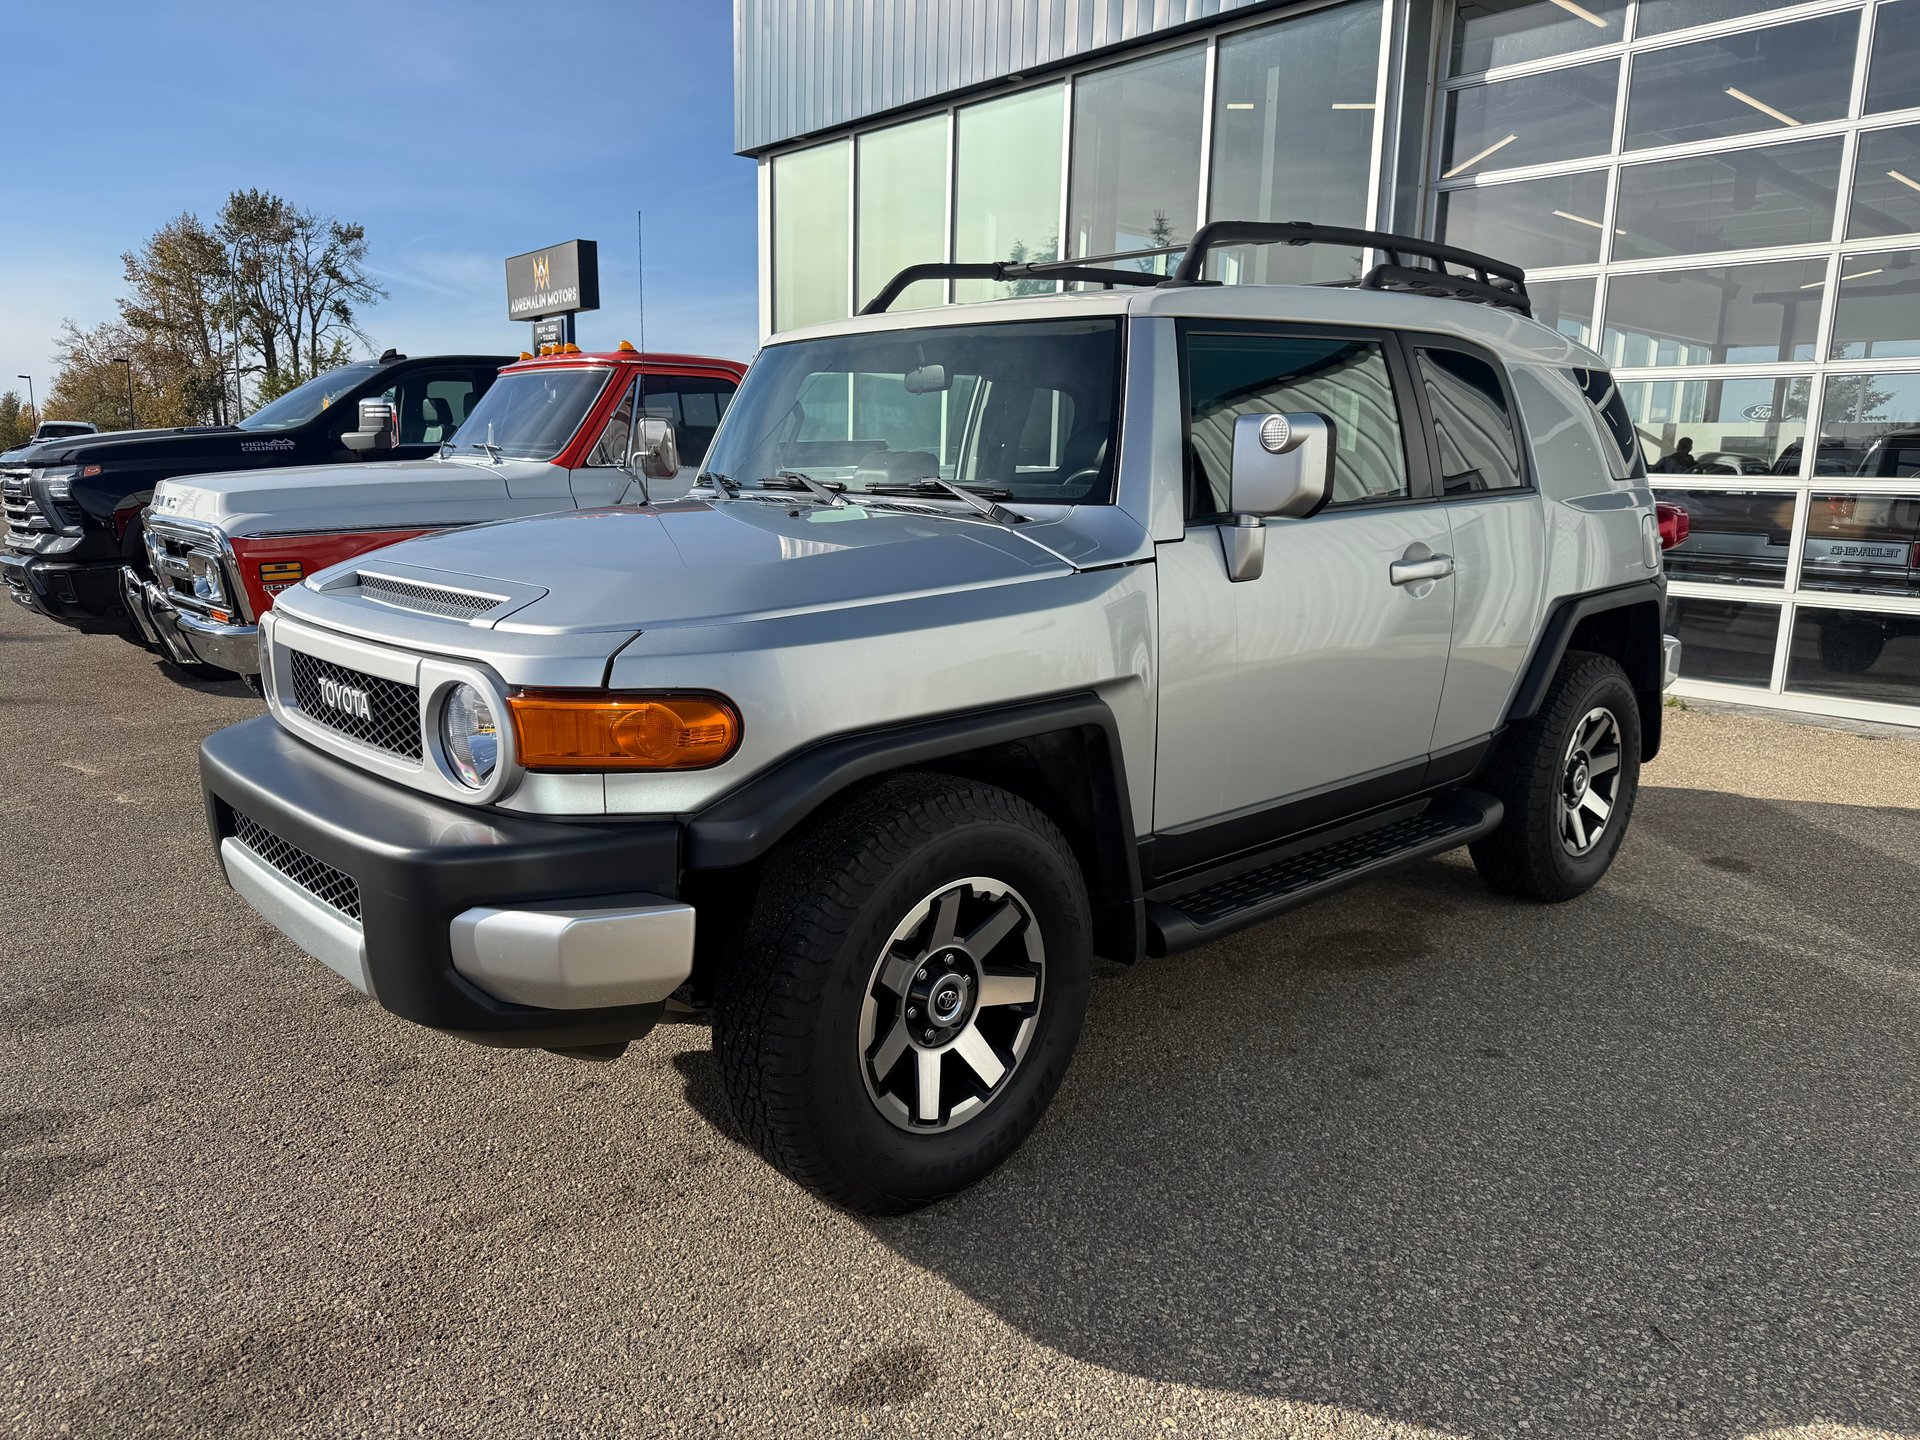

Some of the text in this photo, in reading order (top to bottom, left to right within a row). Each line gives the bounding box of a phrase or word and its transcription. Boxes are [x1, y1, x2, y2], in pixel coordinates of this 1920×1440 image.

[510, 286, 577, 314] ADRENALIN MOTORS
[1829, 545, 1901, 558] CHEVROLET
[318, 677, 375, 722] TOYOTA
